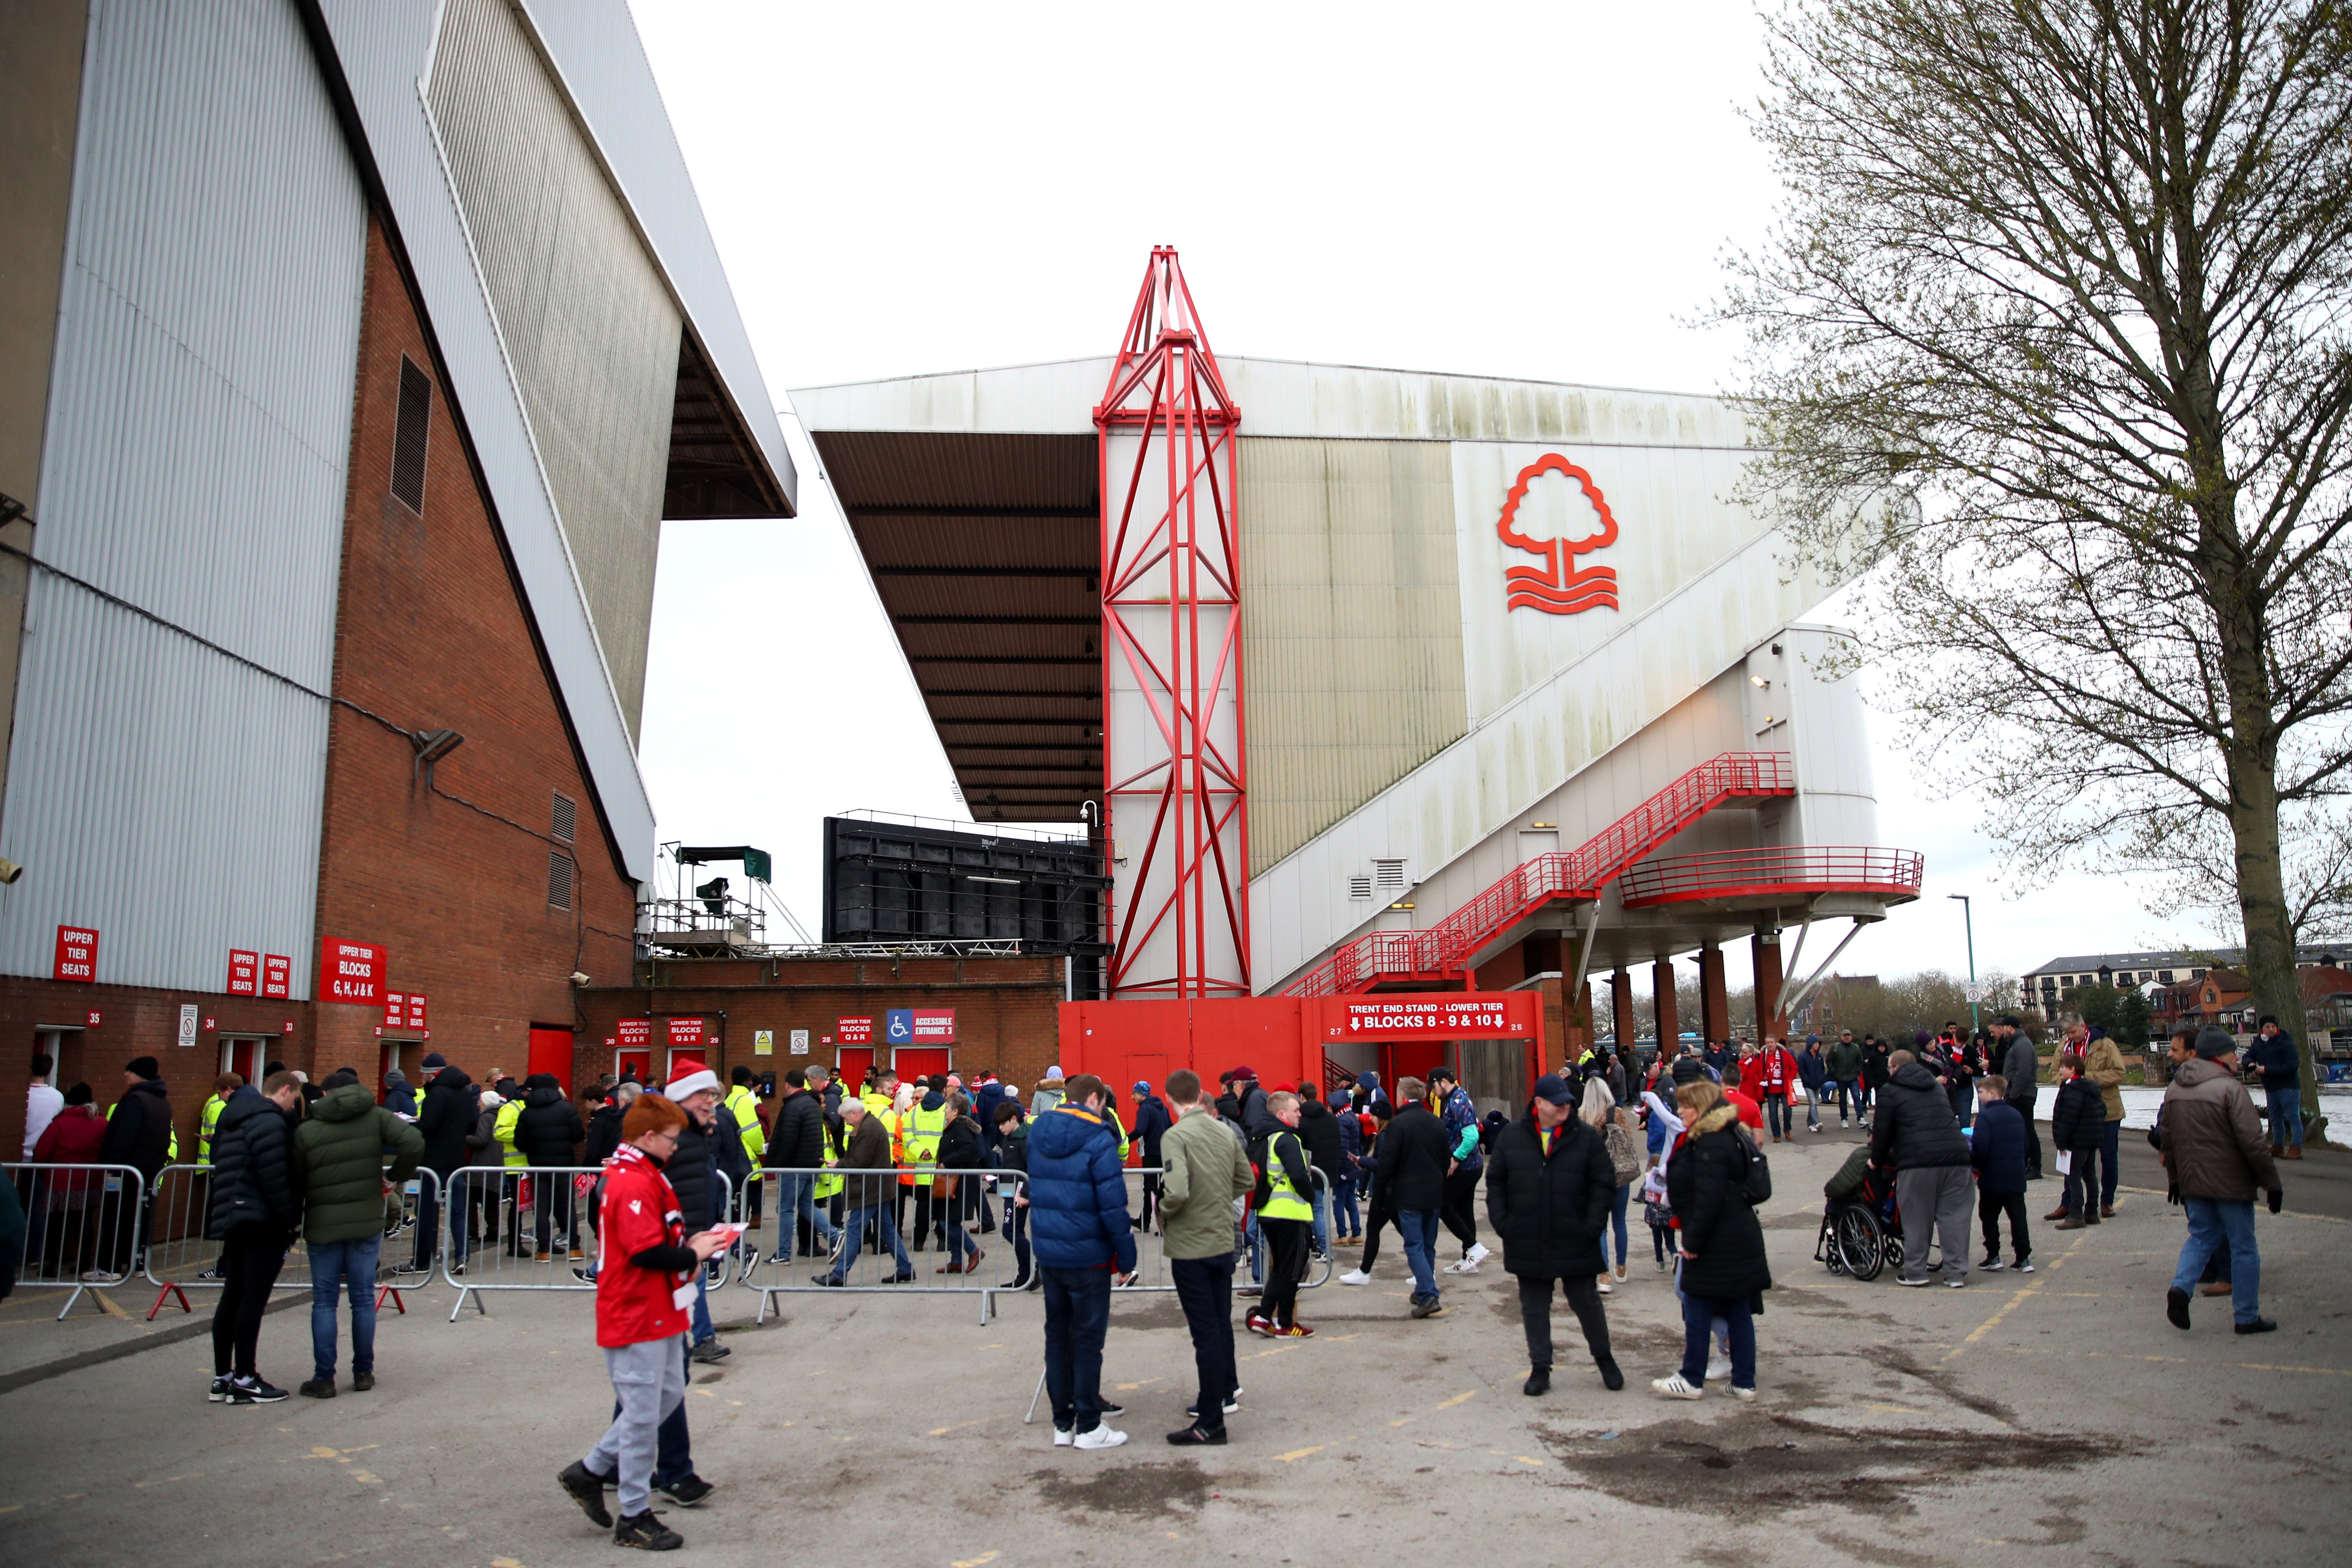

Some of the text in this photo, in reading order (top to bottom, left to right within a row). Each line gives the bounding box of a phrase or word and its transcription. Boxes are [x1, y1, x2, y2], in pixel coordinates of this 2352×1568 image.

[64, 931, 93, 944] UPPER
[67, 947, 87, 960] TIER
[339, 945, 373, 959] UPPER TIER
[233, 953, 254, 965] UPPER
[268, 958, 287, 969] UPPER
[62, 963, 90, 976] SEATS
[236, 967, 251, 977] TIER
[339, 960, 371, 977] BLOCKS
[271, 971, 284, 981] TIER
[233, 980, 253, 991] SEATS
[267, 983, 286, 994] SEATS
[334, 980, 374, 997] G, H, J & K
[388, 994, 402, 1003] UPPER
[411, 996, 425, 1005] UPPER
[389, 1005, 400, 1013] TIER
[413, 1007, 422, 1016] TIER
[1349, 1005, 1381, 1014] TRENT
[1383, 1004, 1403, 1013] END
[1405, 1004, 1437, 1013] STAND
[1446, 1003, 1479, 1011] LOWER
[1481, 1002, 1504, 1011] TIER
[90, 1013, 100, 1024] 35
[206, 1019, 214, 1028] 34
[387, 1016, 401, 1025] SEATS
[410, 1018, 423, 1026] SEATS
[915, 1017, 952, 1026] ACCESSIBLE
[1364, 1015, 1424, 1028] BLOCKS
[1427, 1015, 1436, 1027] 8
[1448, 1015, 1457, 1026] 9
[1461, 1014, 1471, 1026] &
[1475, 1014, 1491, 1026] 10
[286, 1023, 293, 1031] 33
[376, 1027, 382, 1035] 32
[915, 1027, 946, 1035] ENTRANCE
